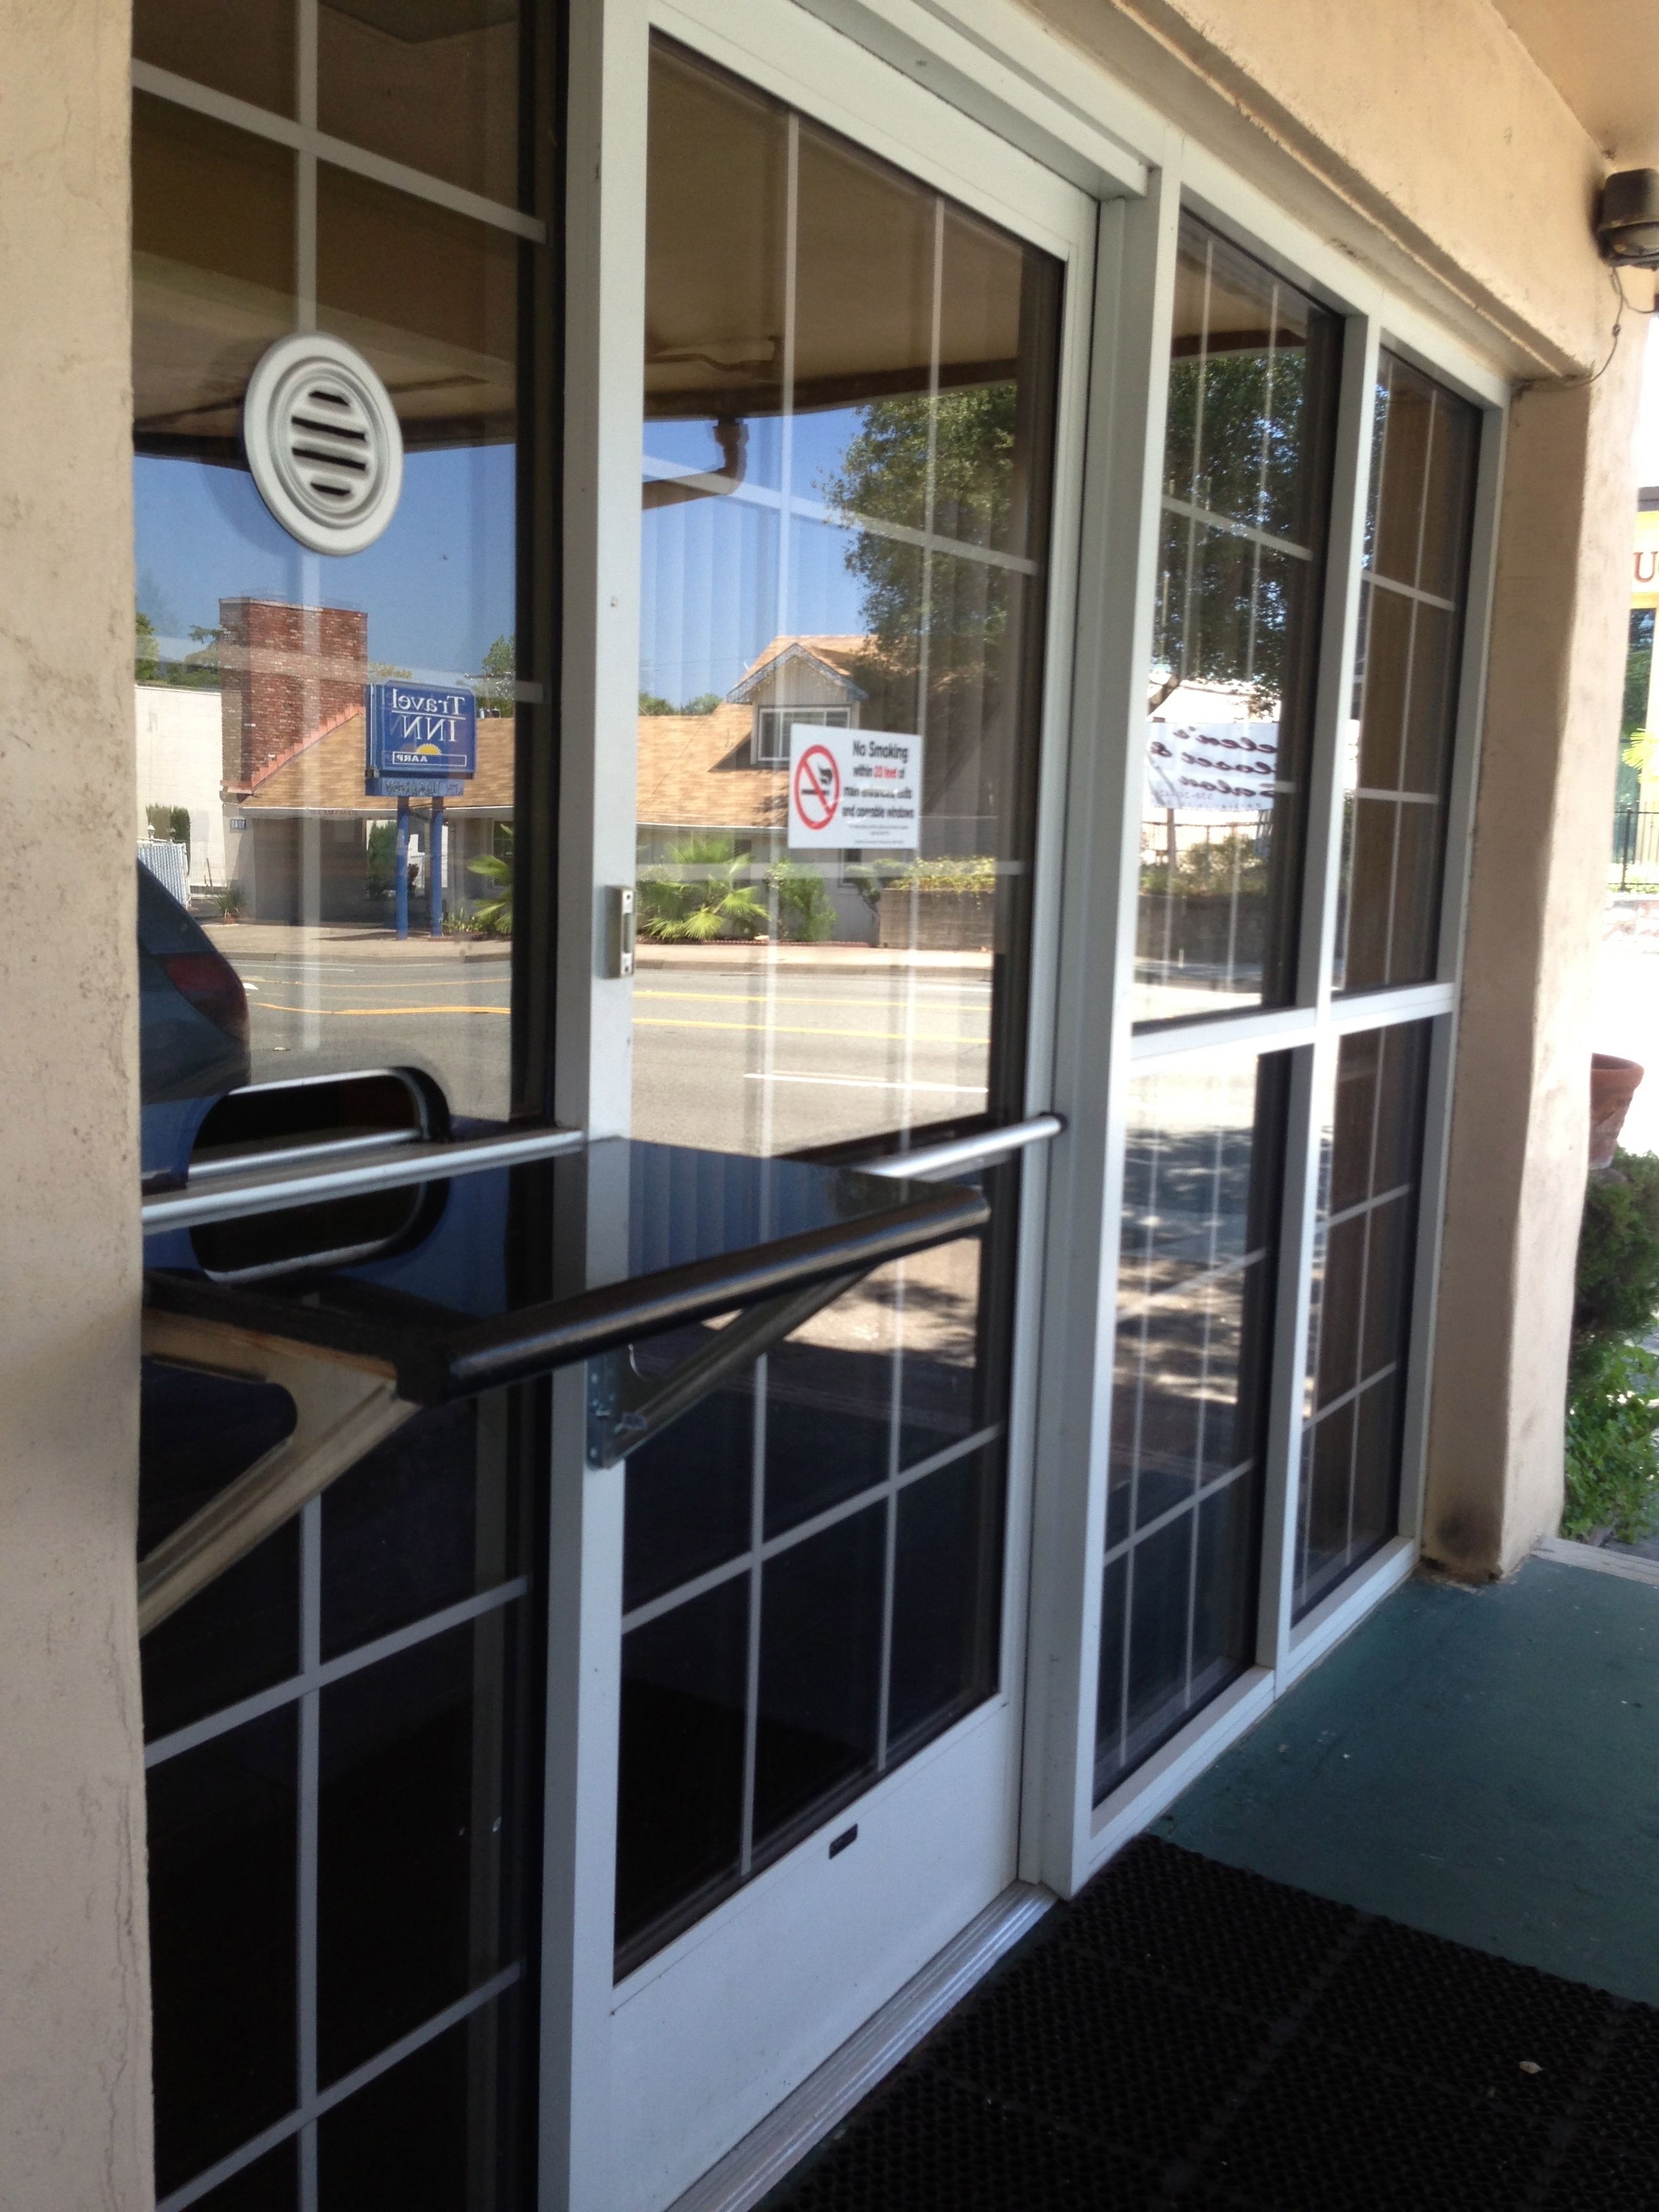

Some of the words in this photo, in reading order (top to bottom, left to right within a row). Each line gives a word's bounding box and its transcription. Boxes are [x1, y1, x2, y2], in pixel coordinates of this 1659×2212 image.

[1633, 551, 1659, 583] U
[853, 740, 865, 757] No
[869, 741, 909, 764] Smoking
